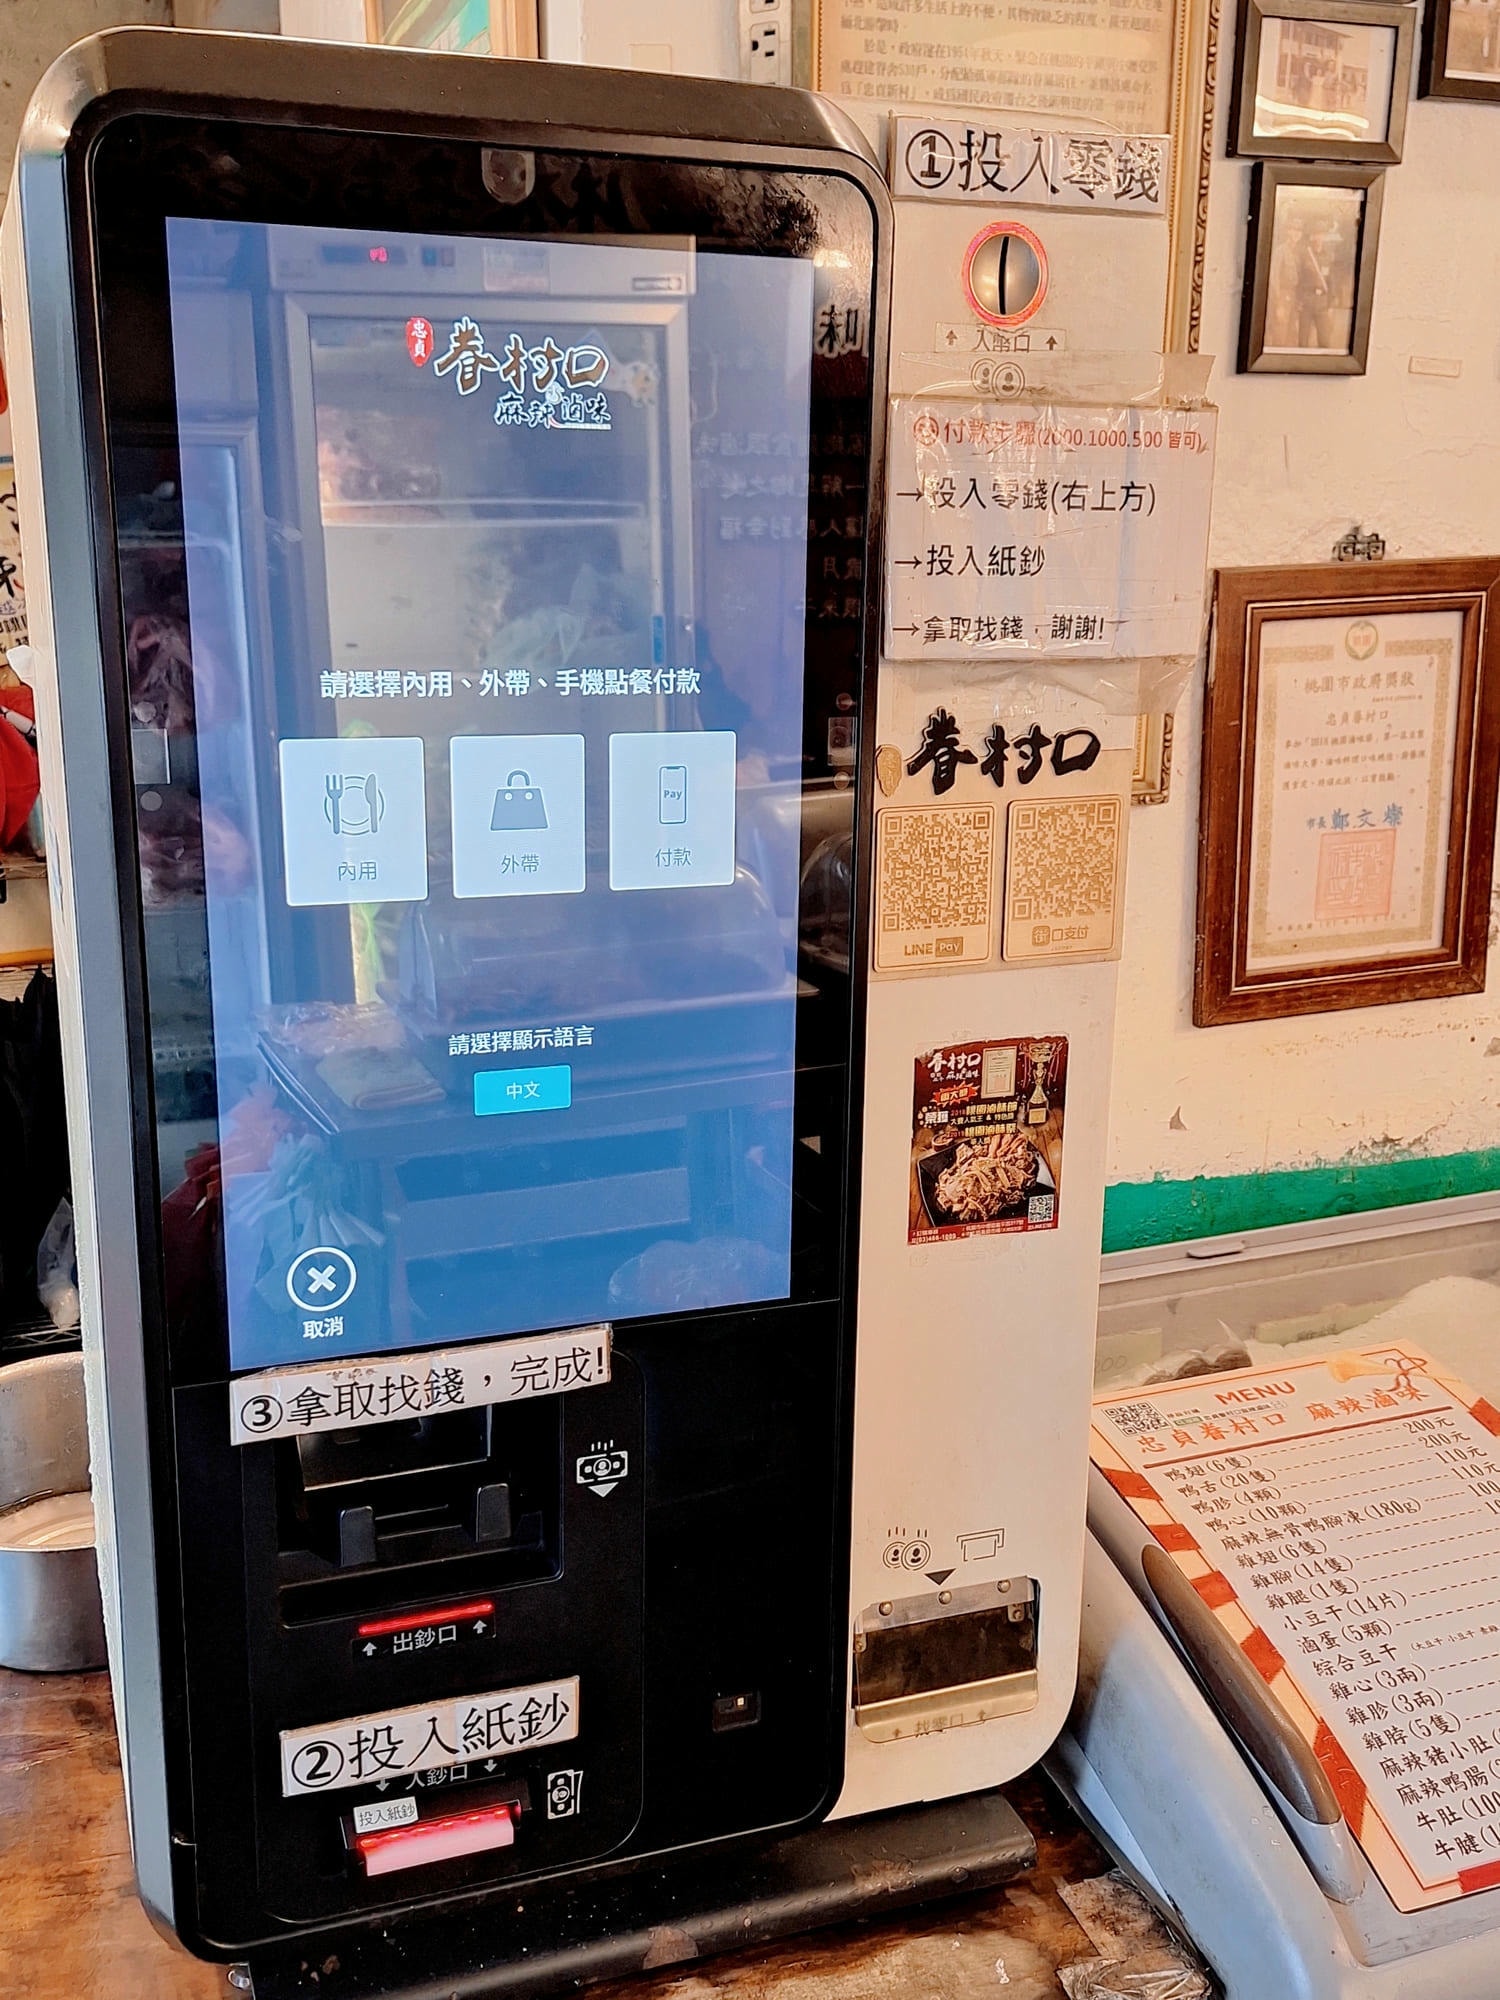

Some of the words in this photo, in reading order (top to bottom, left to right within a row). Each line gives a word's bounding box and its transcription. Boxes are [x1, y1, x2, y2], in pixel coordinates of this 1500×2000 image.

[411, 319, 429, 358] 忠貞
[494, 391, 612, 430] 麻辣滷味
[926, 543, 1046, 577] 投入紙鈔
[663, 788, 683, 802] Pay
[500, 853, 541, 875] 外帶
[655, 847, 693, 869] 付款
[337, 860, 379, 882] 內用
[903, 942, 934, 957] LINE
[939, 940, 962, 956] Pay
[448, 1024, 595, 1057] 請選擇顯示語言
[505, 1080, 541, 1101] 中文
[302, 1316, 344, 1340] 取消
[1214, 1380, 1297, 1406] MENU
[1137, 1412, 1287, 1455] 忠貞眷村口
[1305, 1385, 1429, 1423] 麻辣滷味
[1402, 1414, 1455, 1436] 200元
[1418, 1429, 1472, 1450] 200元
[1434, 1445, 1488, 1465] 110元
[1451, 1461, 1500, 1480] 110元
[392, 1625, 458, 1655] 出鈔口
[1312, 1642, 1399, 1678] 綜合豆干
[1328, 1662, 1427, 1701] 雞心(3兩)
[359, 1803, 416, 1827] 投入紙鈔
